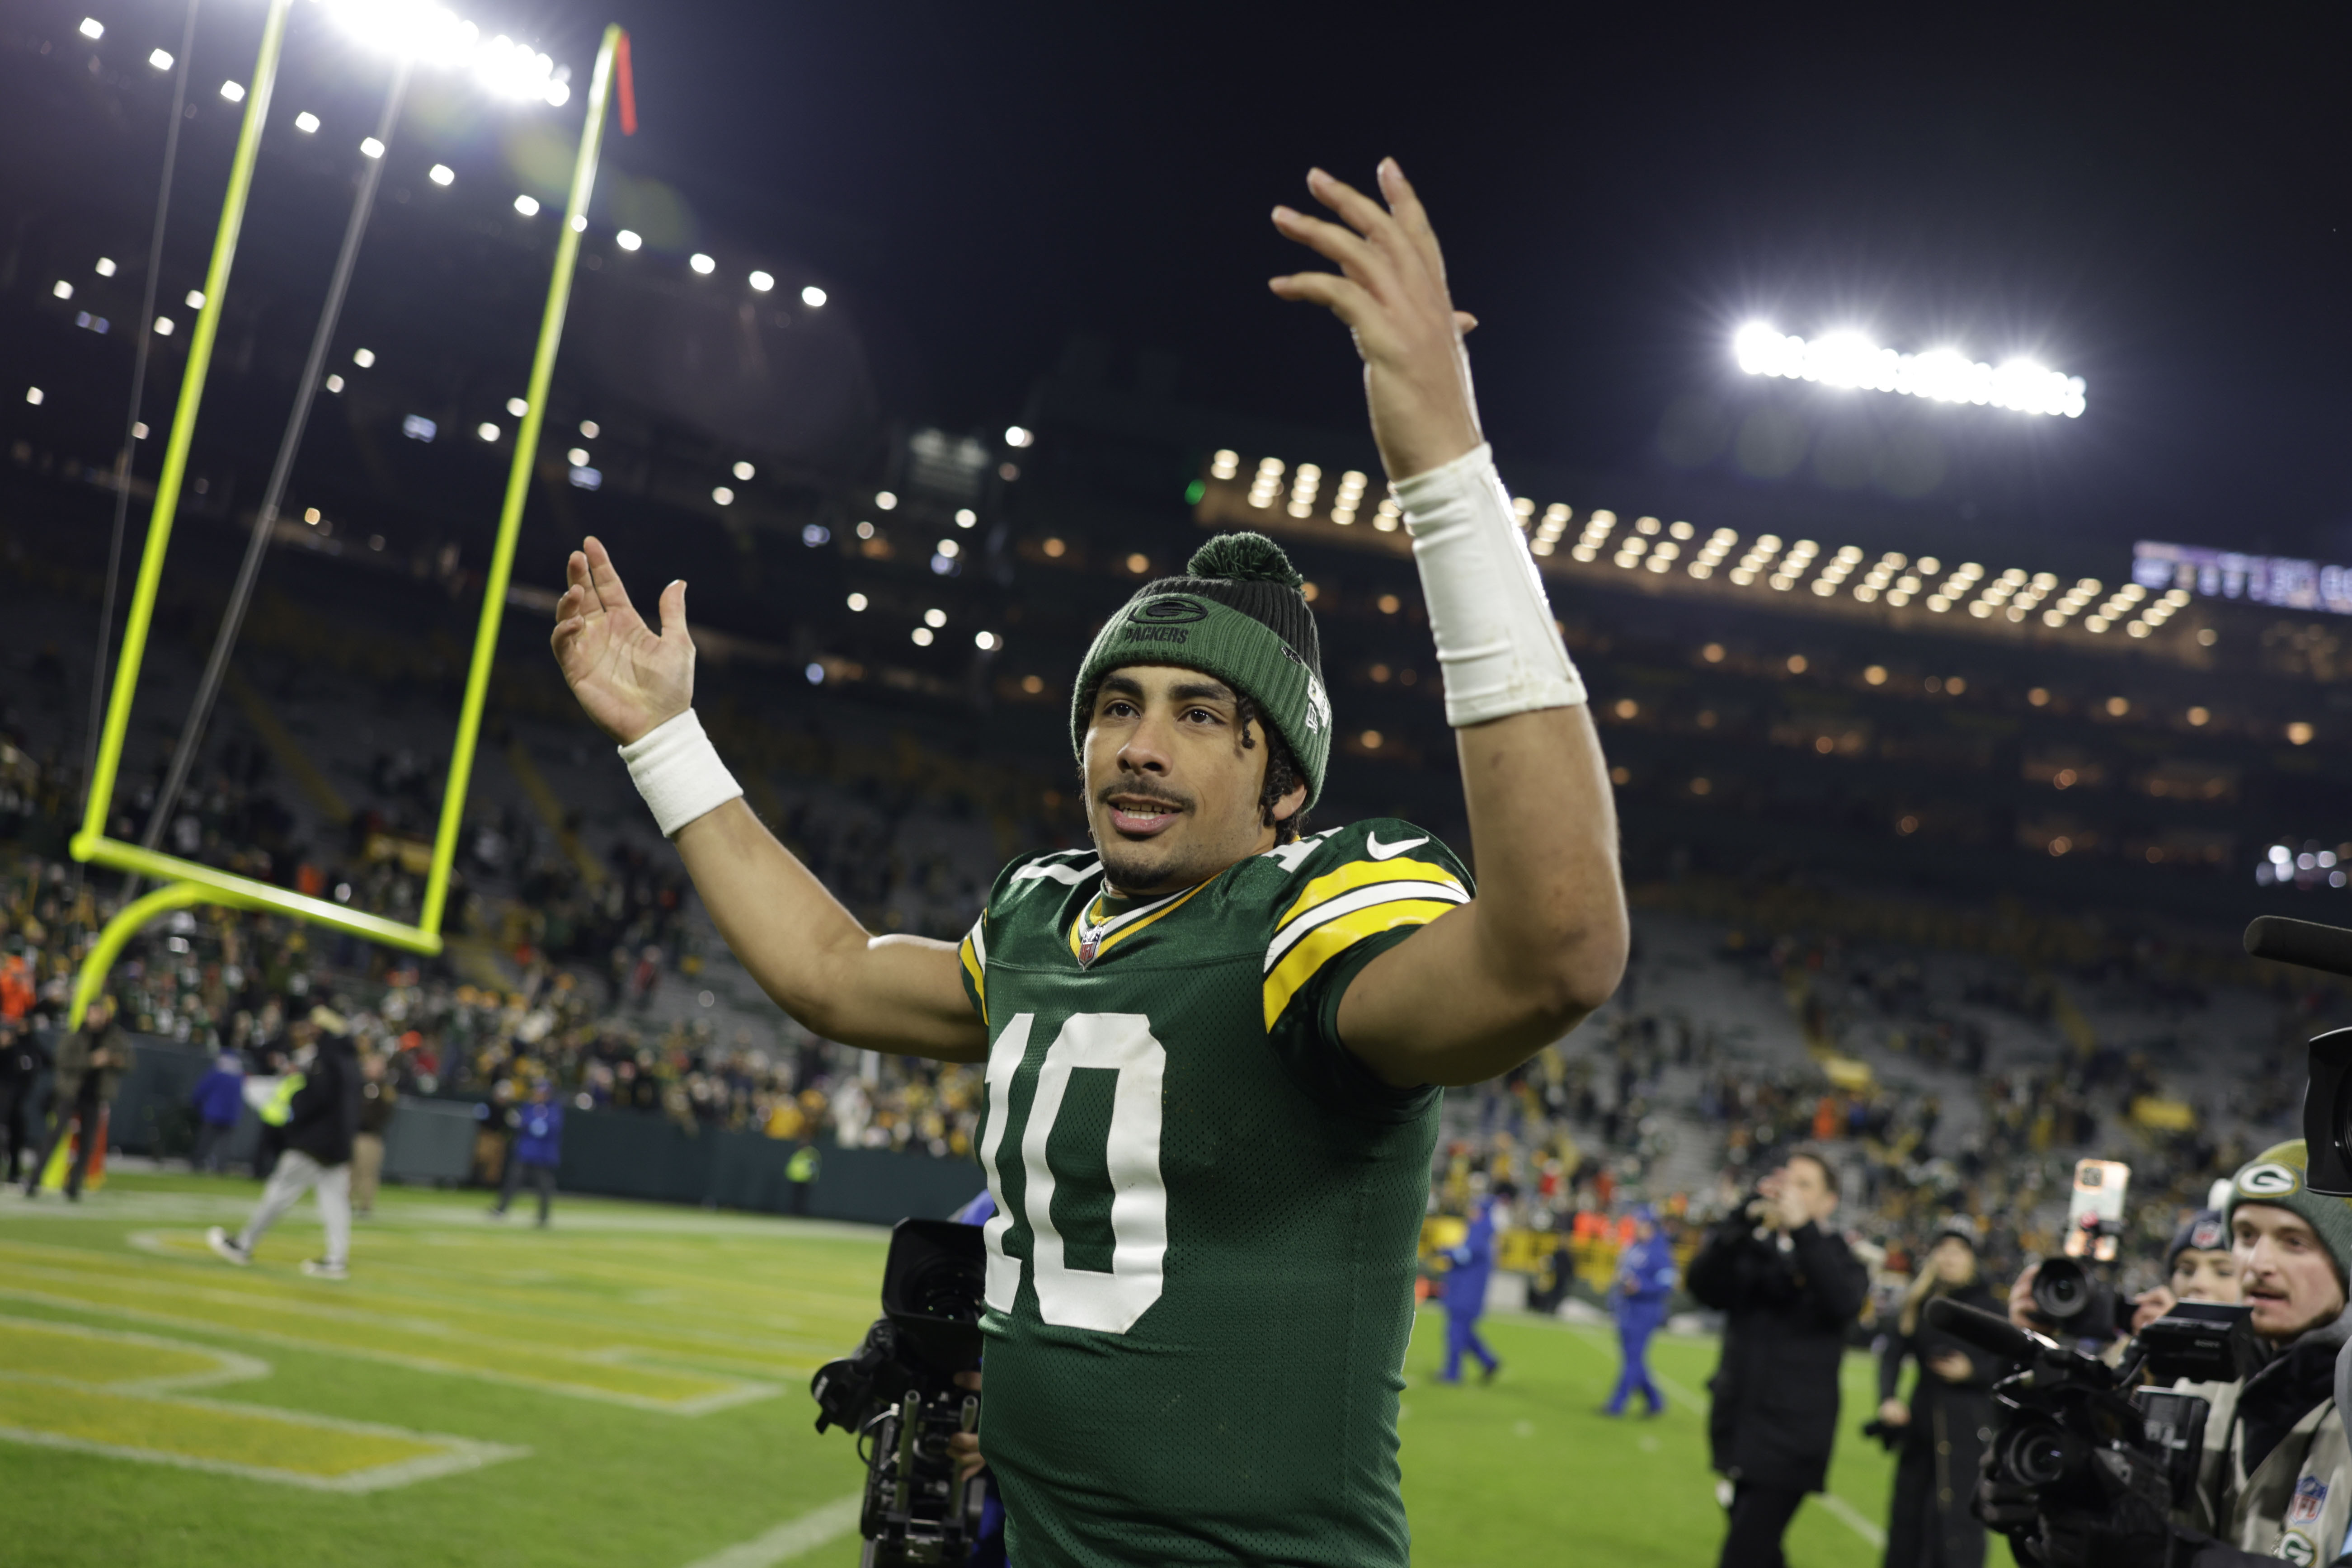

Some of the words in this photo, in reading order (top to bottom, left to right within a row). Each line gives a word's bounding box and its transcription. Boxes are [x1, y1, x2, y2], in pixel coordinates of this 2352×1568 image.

[1124, 626, 1189, 644] PACKERS
[980, 1012, 1167, 1335] 10
[2239, 1163, 2295, 1194] G
